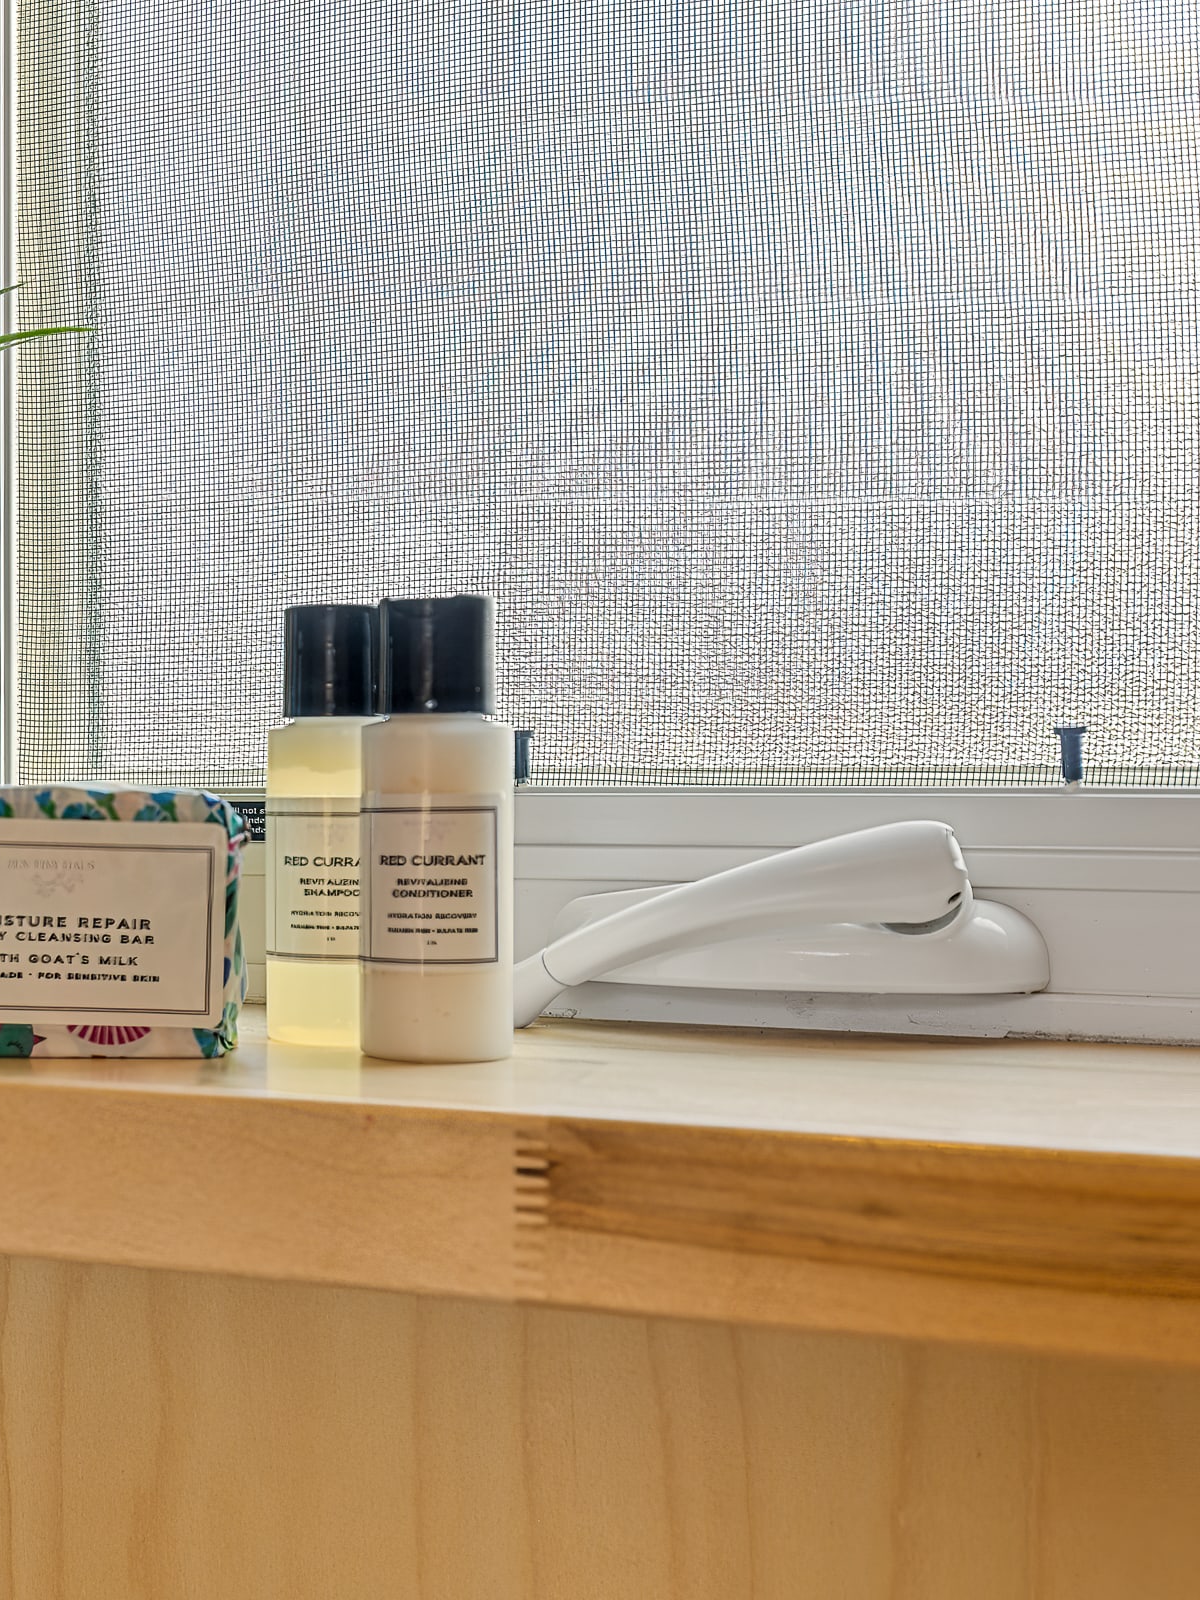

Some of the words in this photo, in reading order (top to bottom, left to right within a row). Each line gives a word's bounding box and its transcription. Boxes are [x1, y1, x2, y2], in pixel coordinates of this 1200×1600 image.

[242, 807, 257, 815] not
[284, 856, 309, 866] RED
[313, 857, 360, 867] CURRA
[379, 855, 407, 866] RED
[411, 855, 486, 866] CURRANT
[300, 878, 360, 886] REVITALIZIN
[397, 878, 468, 886] REVITALIZING
[392, 889, 473, 898] CONDITIONER
[77, 917, 152, 930] REPAIR
[15, 931, 112, 943] CLEANSING
[120, 935, 155, 944] BAR
[28, 952, 90, 965] GOAT'S
[99, 955, 139, 966] MILK
[38, 972, 62, 980] FOR
[67, 972, 128, 982] SENSITIVE
[132, 975, 160, 983] SKIN
